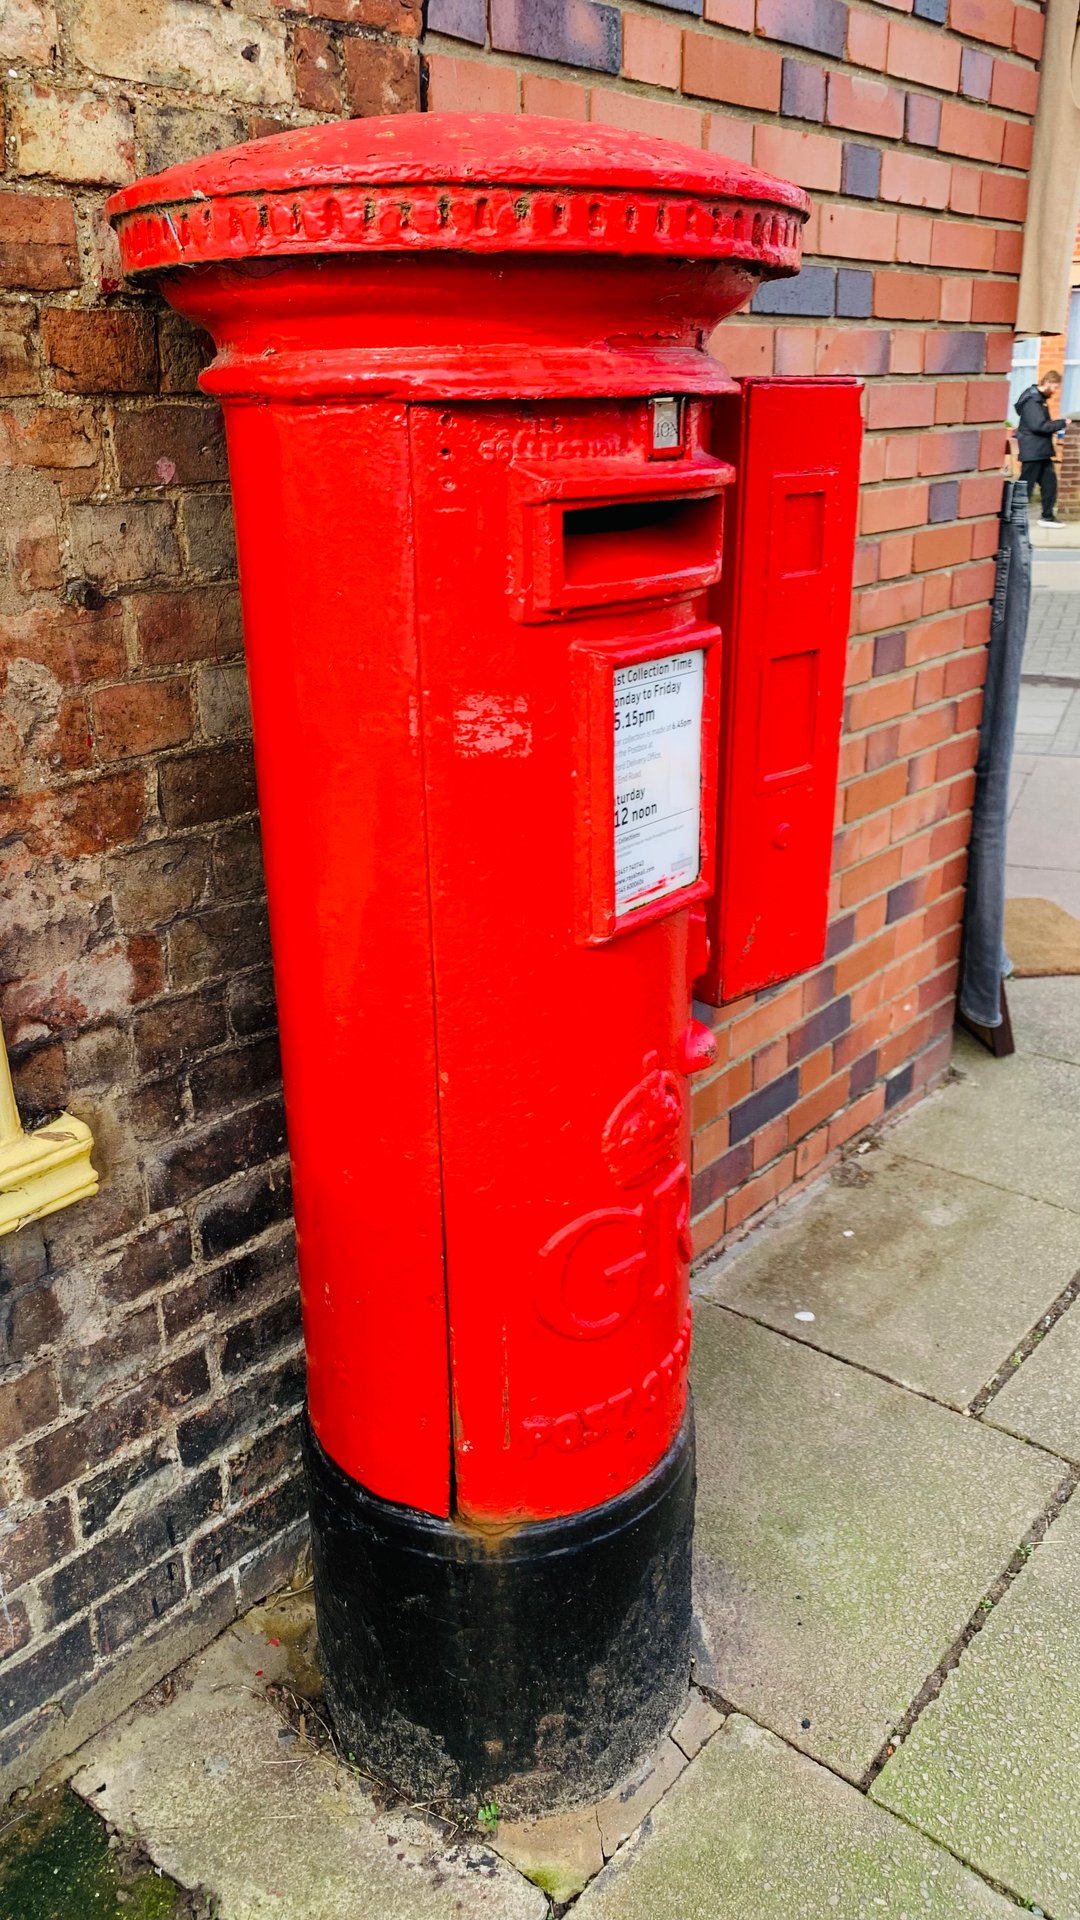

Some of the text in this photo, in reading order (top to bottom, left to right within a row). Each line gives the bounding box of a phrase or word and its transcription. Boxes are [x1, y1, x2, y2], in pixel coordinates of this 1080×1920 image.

[628, 664, 670, 682] Collection
[672, 658, 692, 671] Time
[614, 681, 681, 708] onday to Friday
[614, 709, 655, 731] 5.15pm
[672, 719, 692, 730] 6.45pm
[615, 787, 645, 805] turday
[614, 803, 657, 828] 12 noon
